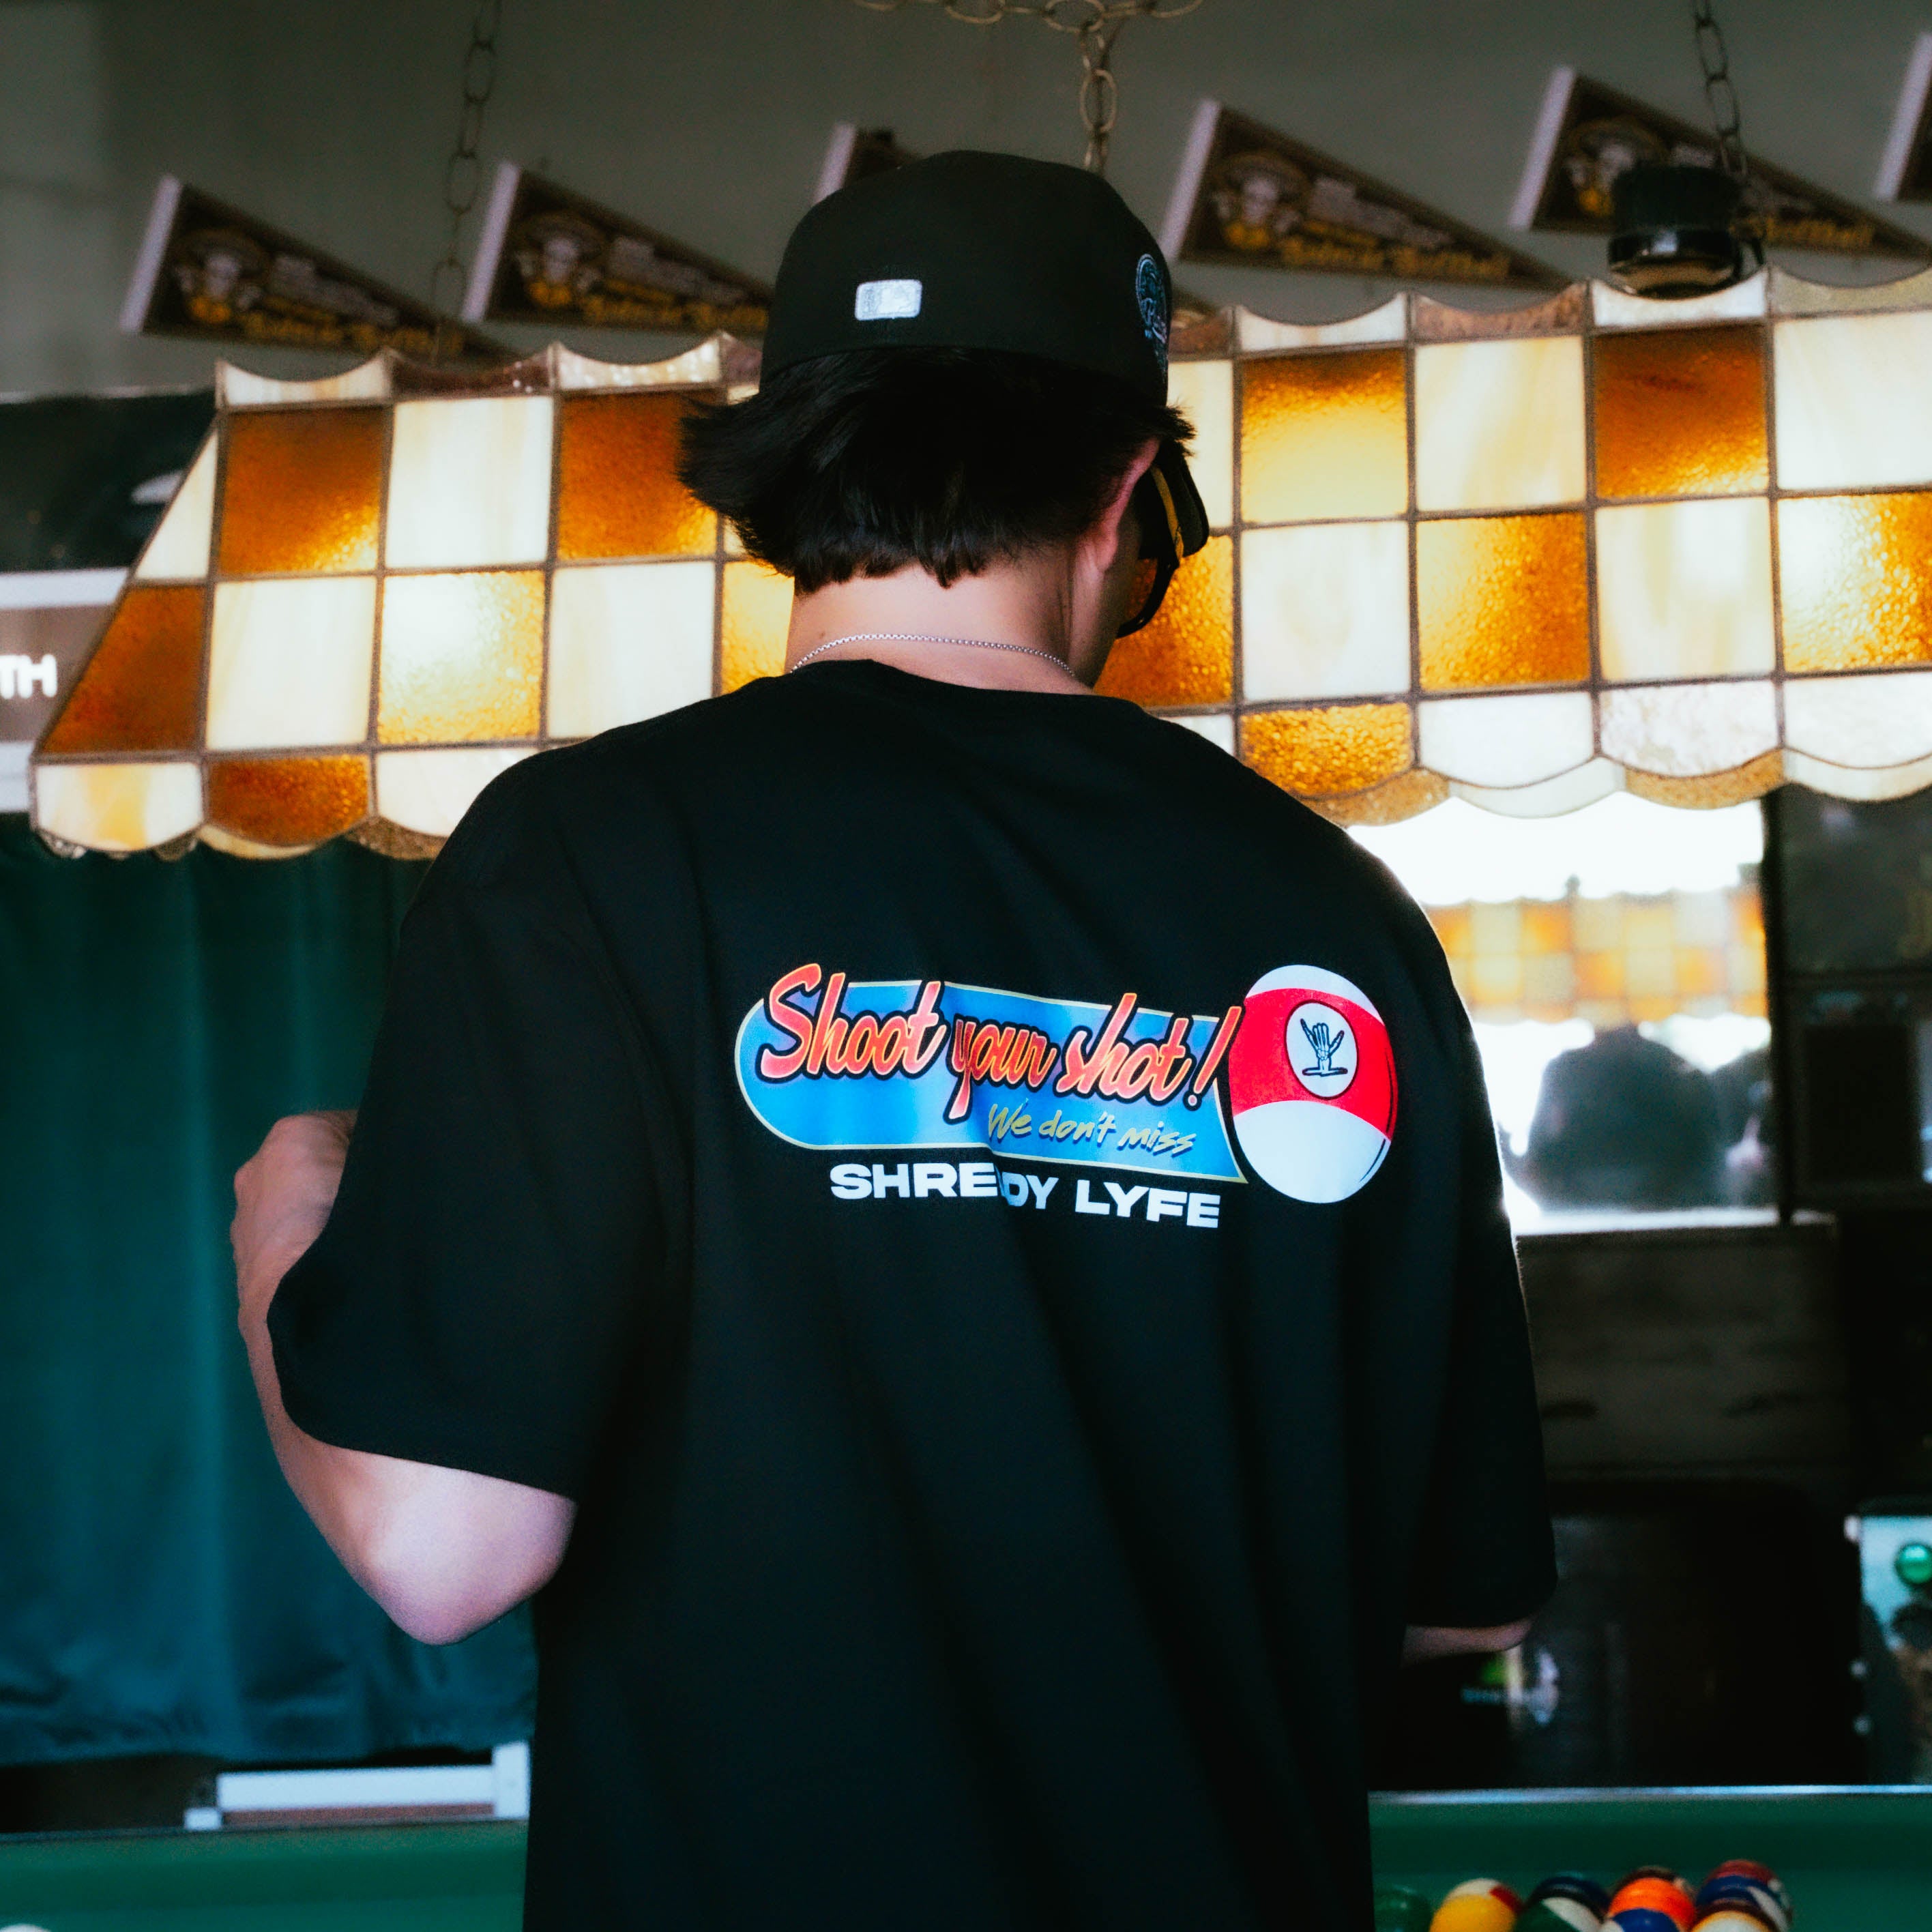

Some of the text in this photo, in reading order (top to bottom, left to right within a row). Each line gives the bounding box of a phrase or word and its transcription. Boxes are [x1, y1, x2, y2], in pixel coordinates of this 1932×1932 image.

[759, 963, 1242, 1120] Shoot your shot!
[989, 1100, 1197, 1157] We don't miss
[830, 1162, 1221, 1229] SHREDY LYFE
